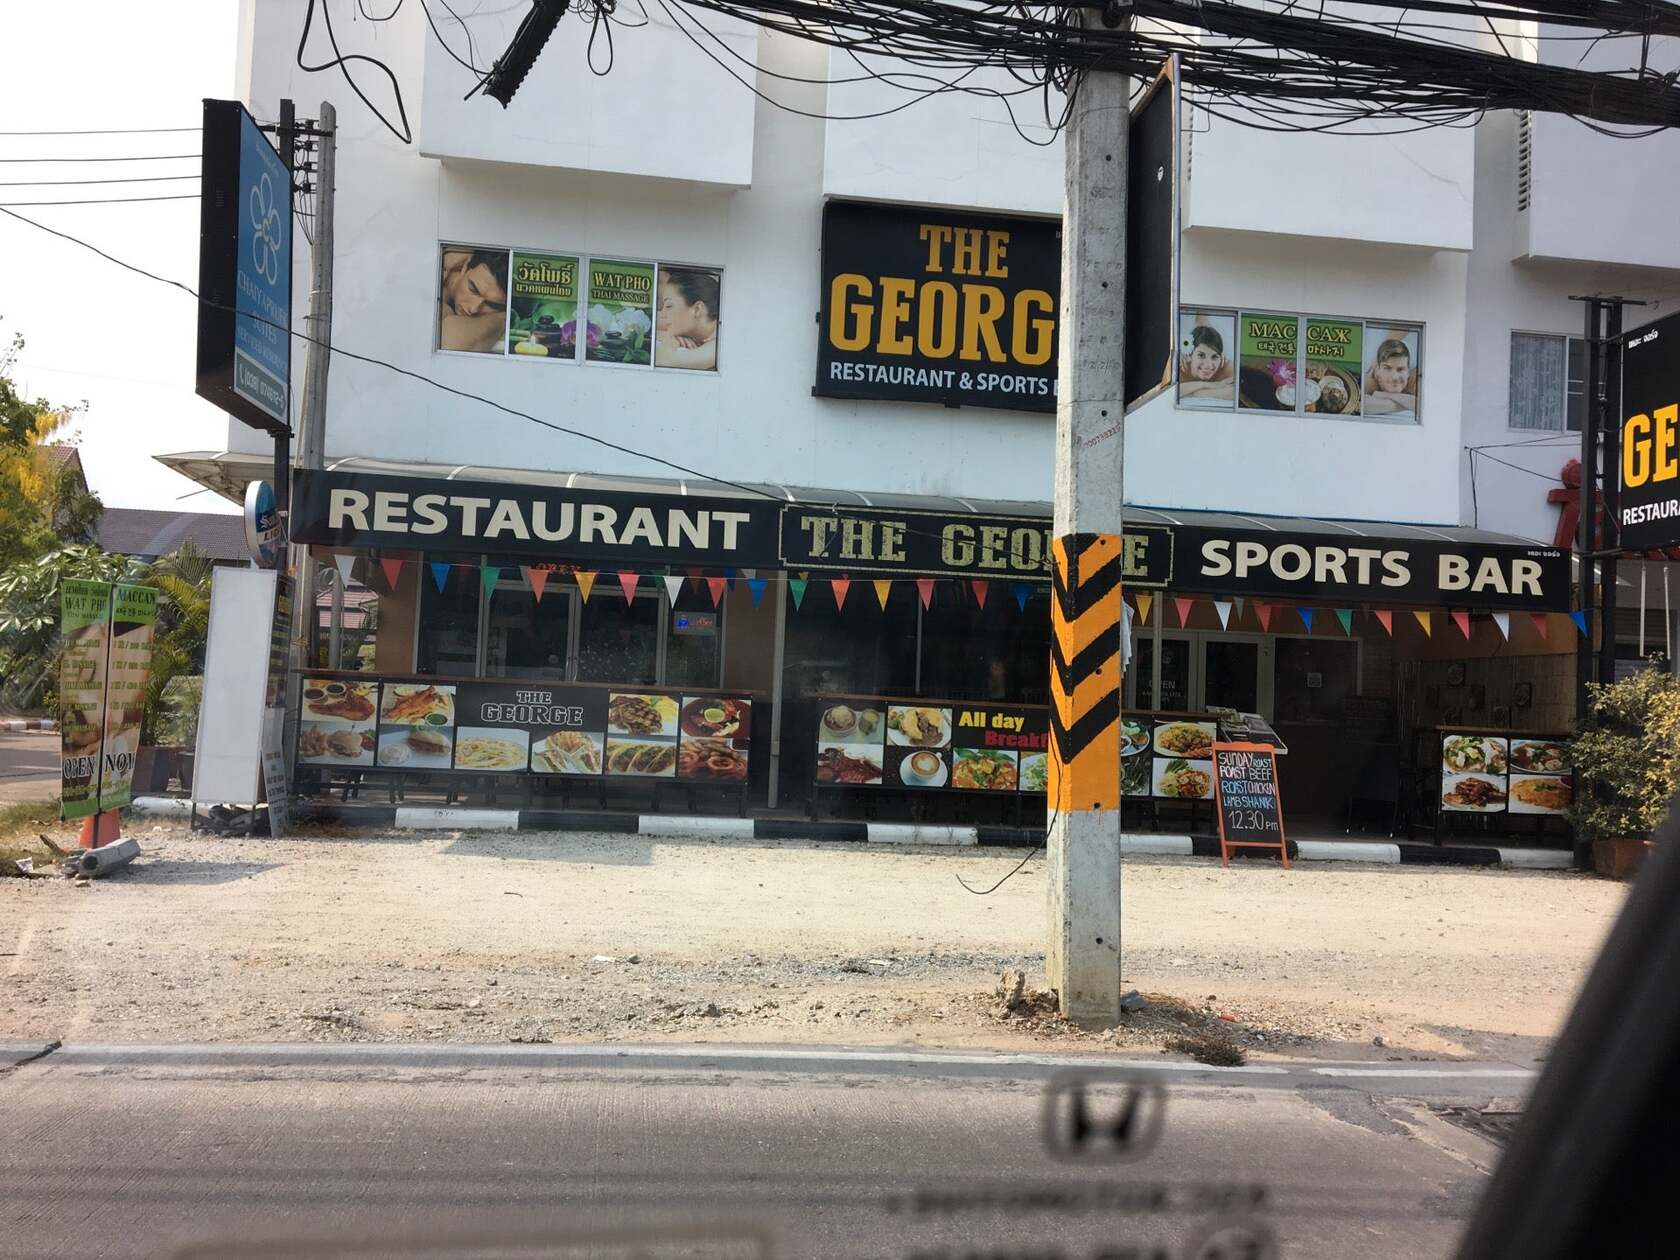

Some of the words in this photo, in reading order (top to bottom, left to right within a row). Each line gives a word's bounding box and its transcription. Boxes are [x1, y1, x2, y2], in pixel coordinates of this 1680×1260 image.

[920, 224, 1010, 278] THE
[594, 272, 622, 288] WAT
[625, 276, 651, 291] PHO
[592, 289, 612, 299] THAI
[614, 292, 649, 303] MASSAGE
[829, 273, 1059, 366] GEORG
[830, 361, 955, 389] RESTAURANT
[959, 372, 973, 390] &
[976, 373, 1048, 396] SPORTS
[328, 488, 750, 550] RESTAURANT
[1623, 499, 1680, 526] RESTAUR
[801, 516, 907, 562] THE
[941, 524, 1150, 577] GEOE
[1200, 539, 1411, 587] SPORTS
[1438, 554, 1544, 596] BAR
[516, 691, 552, 704] THE
[481, 703, 583, 725] GEORGE
[959, 711, 987, 728] All
[992, 713, 1025, 732] day
[63, 757, 95, 779] OPEN
[1218, 752, 1254, 767] SUNDAY
[1219, 766, 1247, 779] ROAST
[1249, 767, 1273, 781] BEEF
[1221, 780, 1248, 794] ROAST
[1242, 796, 1274, 809] SHANK
[1229, 810, 1264, 830] 12.30
